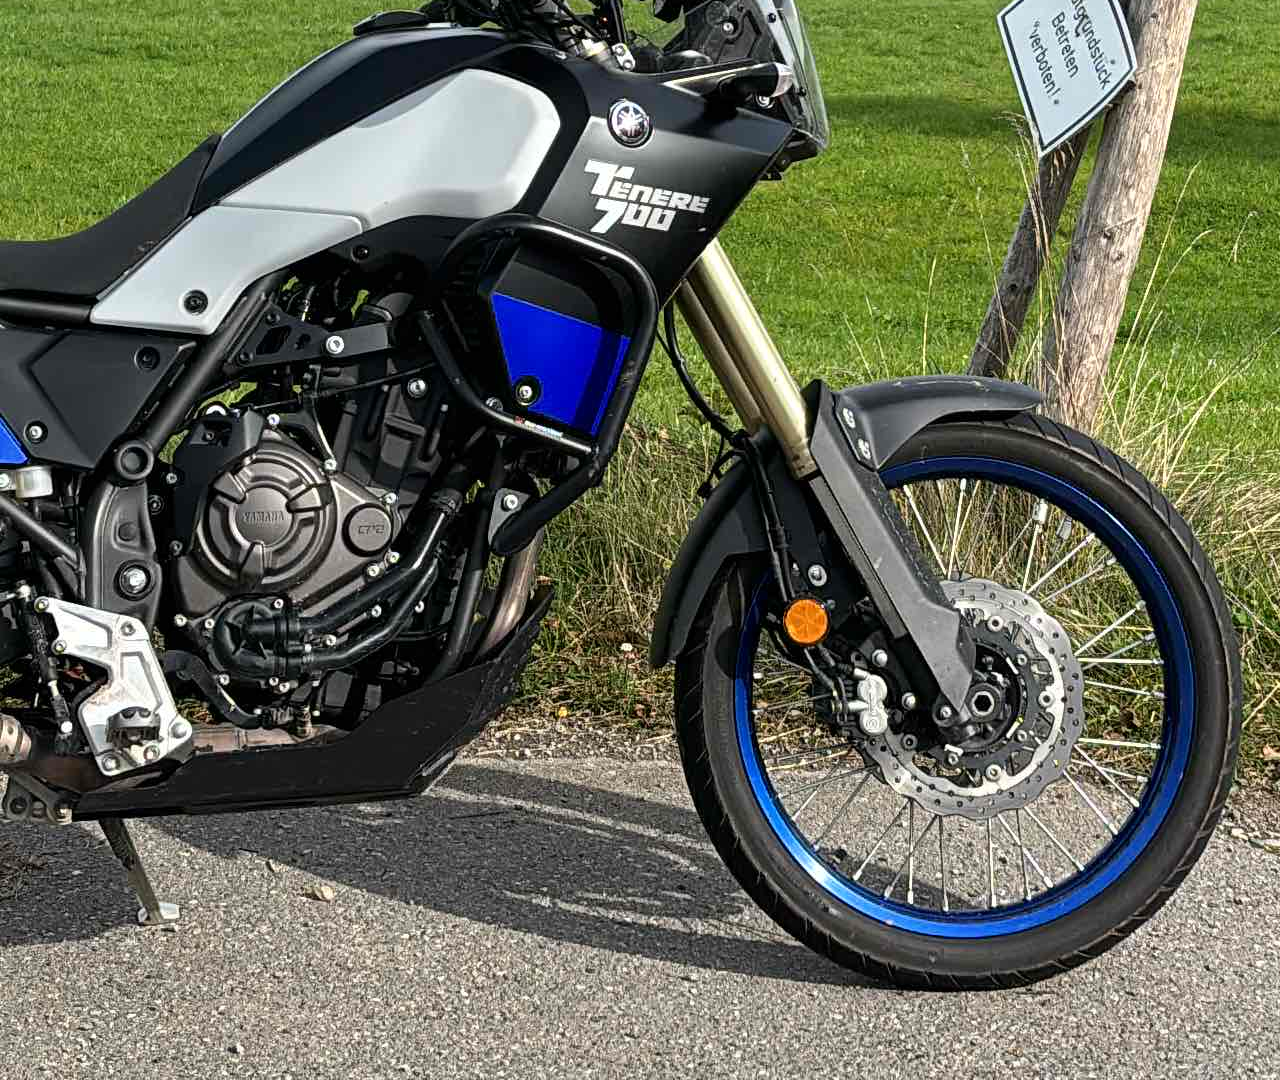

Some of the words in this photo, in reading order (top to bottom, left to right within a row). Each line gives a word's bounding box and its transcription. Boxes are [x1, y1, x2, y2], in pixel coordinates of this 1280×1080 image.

[1029, 27, 1061, 98] verboten!
[1051, 11, 1080, 78] Betreten
[590, 197, 677, 234] 700
